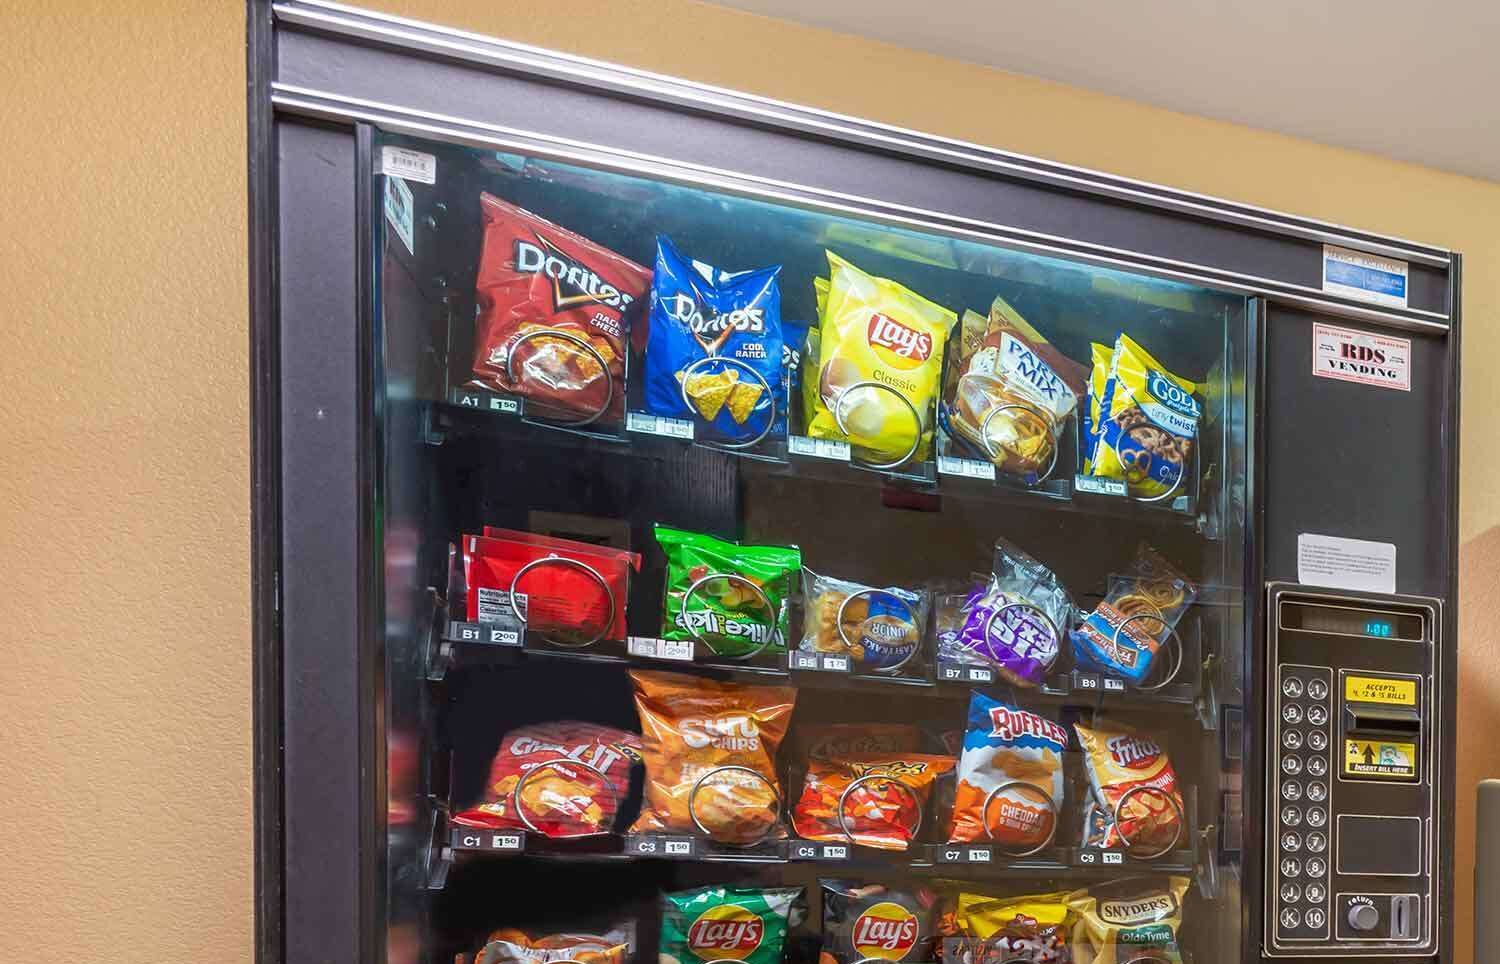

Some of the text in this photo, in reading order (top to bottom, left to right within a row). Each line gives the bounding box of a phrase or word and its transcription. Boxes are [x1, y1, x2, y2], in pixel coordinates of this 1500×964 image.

[518, 240, 634, 312] Doritos
[676, 293, 764, 333] Doritos
[870, 314, 931, 357] Lay's
[742, 343, 765, 351] COOL
[735, 350, 767, 359] RANCH
[1339, 342, 1386, 365] RDS
[1010, 340, 1072, 398] PARTY
[1328, 359, 1397, 379] VENDING
[872, 369, 917, 393] Classic
[1016, 362, 1057, 400] MIX
[460, 395, 479, 407] A1
[462, 629, 480, 639] B1
[799, 657, 818, 666] B5
[945, 669, 961, 678] B7
[1082, 679, 1096, 688] B9
[1365, 683, 1396, 692] ACCEPTS
[988, 706, 1069, 748] RUFFLES
[711, 738, 759, 752] CHIPS
[1105, 735, 1161, 767] Fritos
[1000, 803, 1044, 825] CHEDDAR
[463, 836, 481, 846] C1
[639, 843, 656, 852] C3
[798, 847, 814, 857] C5
[945, 851, 960, 860] C7
[1080, 854, 1094, 863] C9
[1347, 896, 1375, 906] return
[1104, 898, 1170, 918] SNYDER'S
[1308, 913, 1321, 923] 10
[693, 920, 760, 950] Lay's
[857, 916, 915, 949] Lay's
[1146, 930, 1170, 942] Tyme
